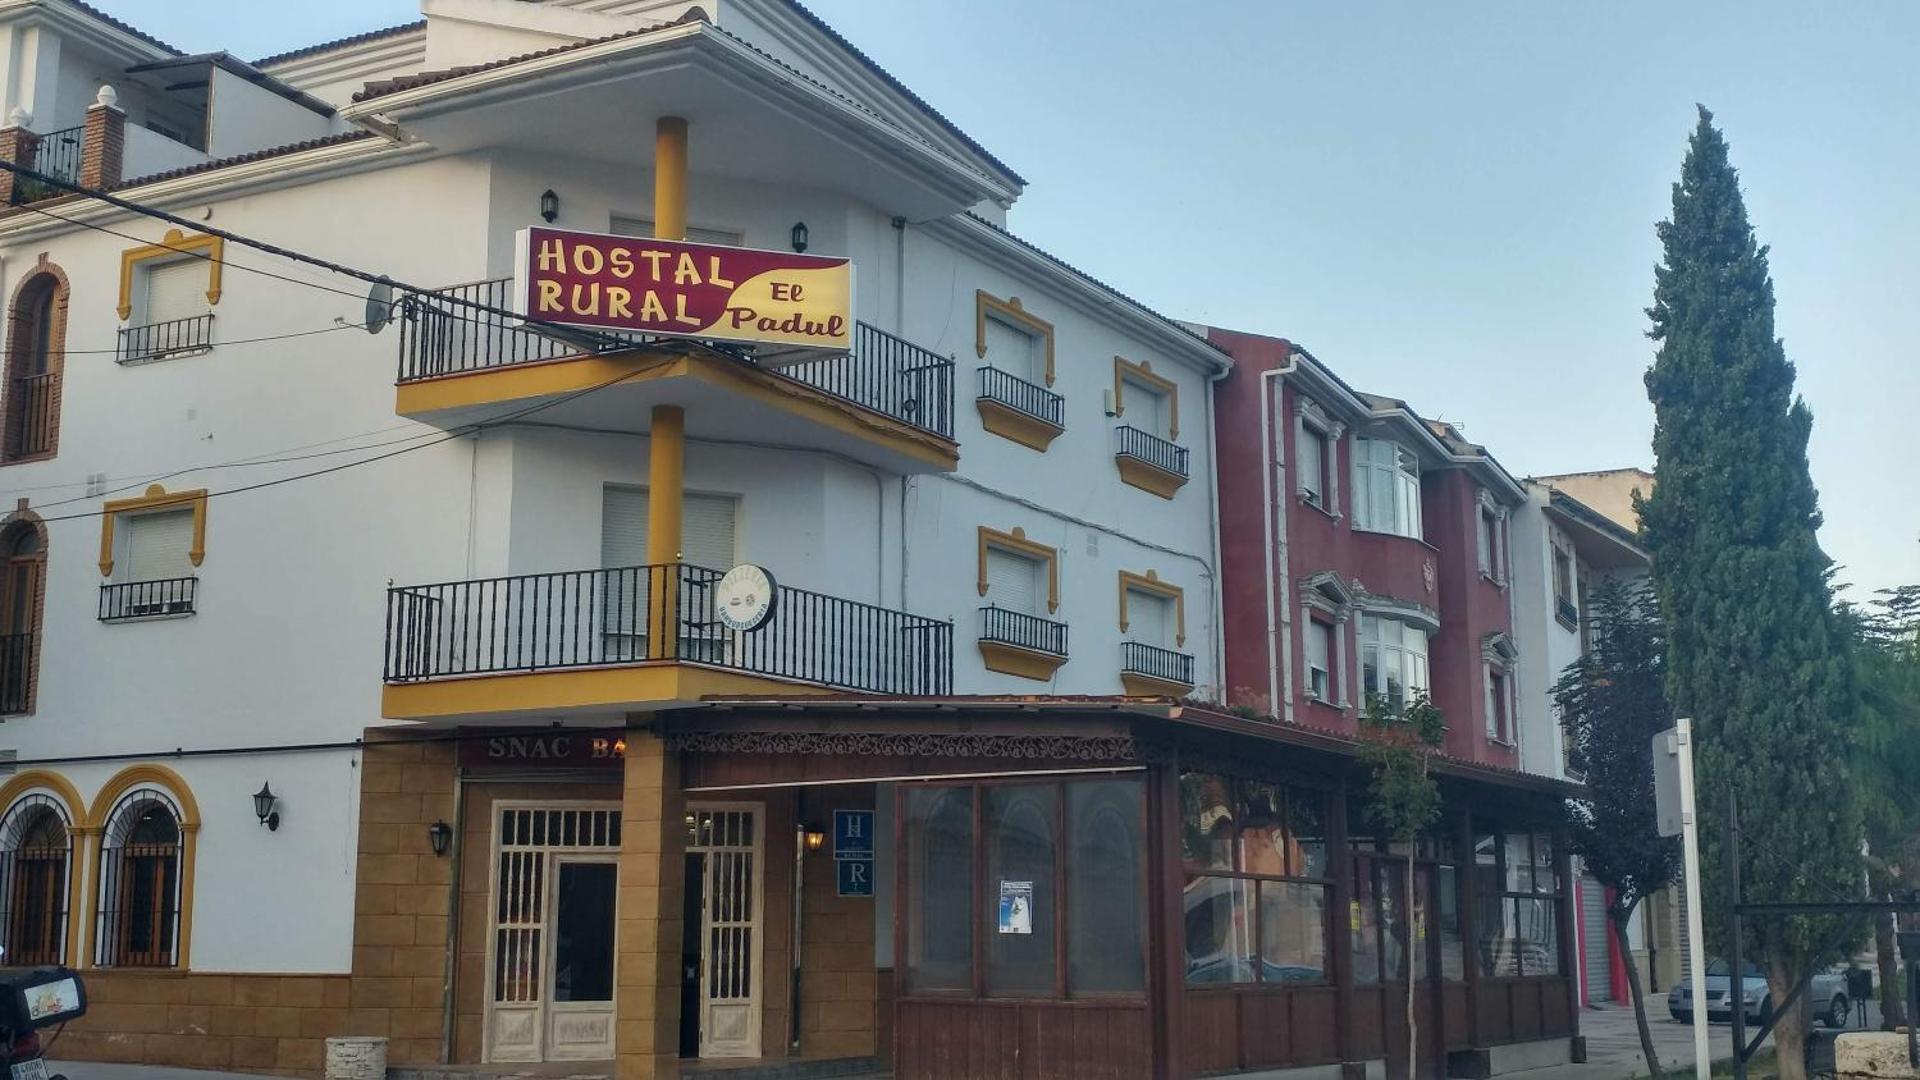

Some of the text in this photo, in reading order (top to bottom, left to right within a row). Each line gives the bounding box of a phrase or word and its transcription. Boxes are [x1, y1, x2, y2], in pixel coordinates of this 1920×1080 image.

[538, 239, 735, 289] HOSTAL
[538, 279, 701, 326] RURAL
[770, 282, 805, 302] El
[727, 306, 846, 337] Padul
[488, 736, 571, 758] SNAC
[850, 863, 866, 882] R
